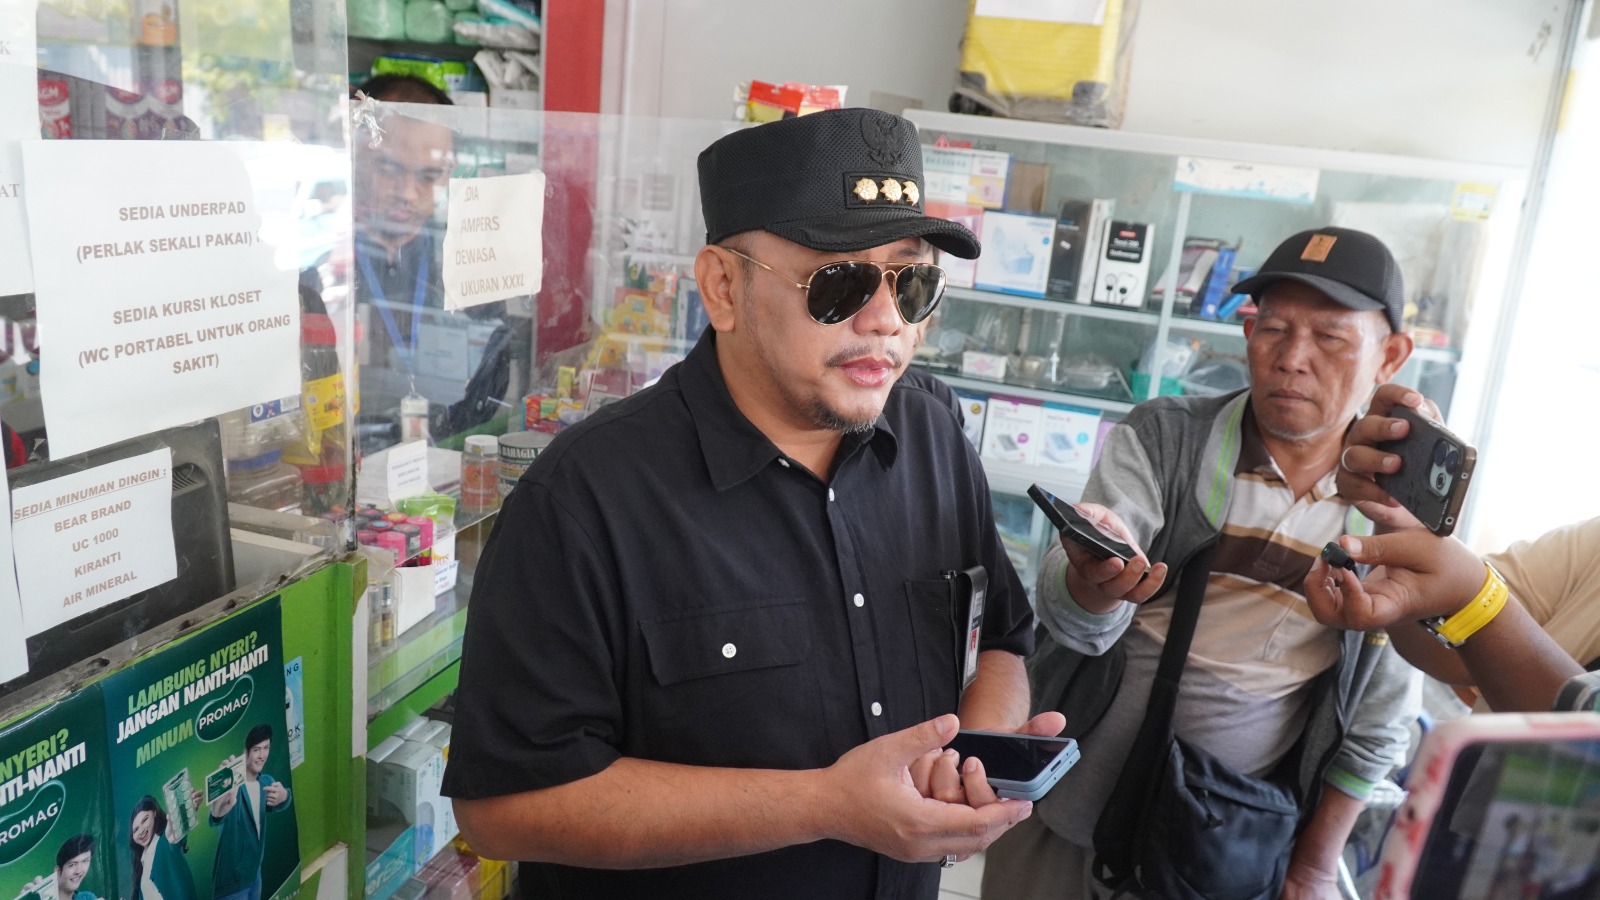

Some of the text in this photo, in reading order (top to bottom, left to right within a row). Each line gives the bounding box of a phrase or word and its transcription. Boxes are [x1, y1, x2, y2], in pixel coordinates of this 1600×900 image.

[119, 201, 246, 221] SEDIA UNDERPAD
[77, 230, 252, 263] (PERLAK SEKALI PAKAI)
[456, 246, 497, 266] DEWASA
[461, 277, 499, 297] UKURAN
[113, 289, 262, 325] SEDIA KURSI KLOSET
[78, 313, 291, 369] (WC PORTABEL UNTUK ORANG
[172, 353, 219, 374] SAKIT)
[14, 499, 52, 520] SEDIA
[55, 480, 115, 508] MINUMAN
[118, 468, 160, 488] DINGIN
[54, 499, 132, 534] BEAR BRAND
[72, 527, 119, 553] UC 1000
[74, 551, 121, 578] KIRANTI
[62, 571, 138, 608] AIR MINERAL
[128, 631, 258, 715] LAMBUNG NYERI?
[116, 644, 269, 744] JANGAN NANTI-NANTI
[136, 693, 249, 768] MINUM PROMAG
[0, 728, 69, 782] NYERI?
